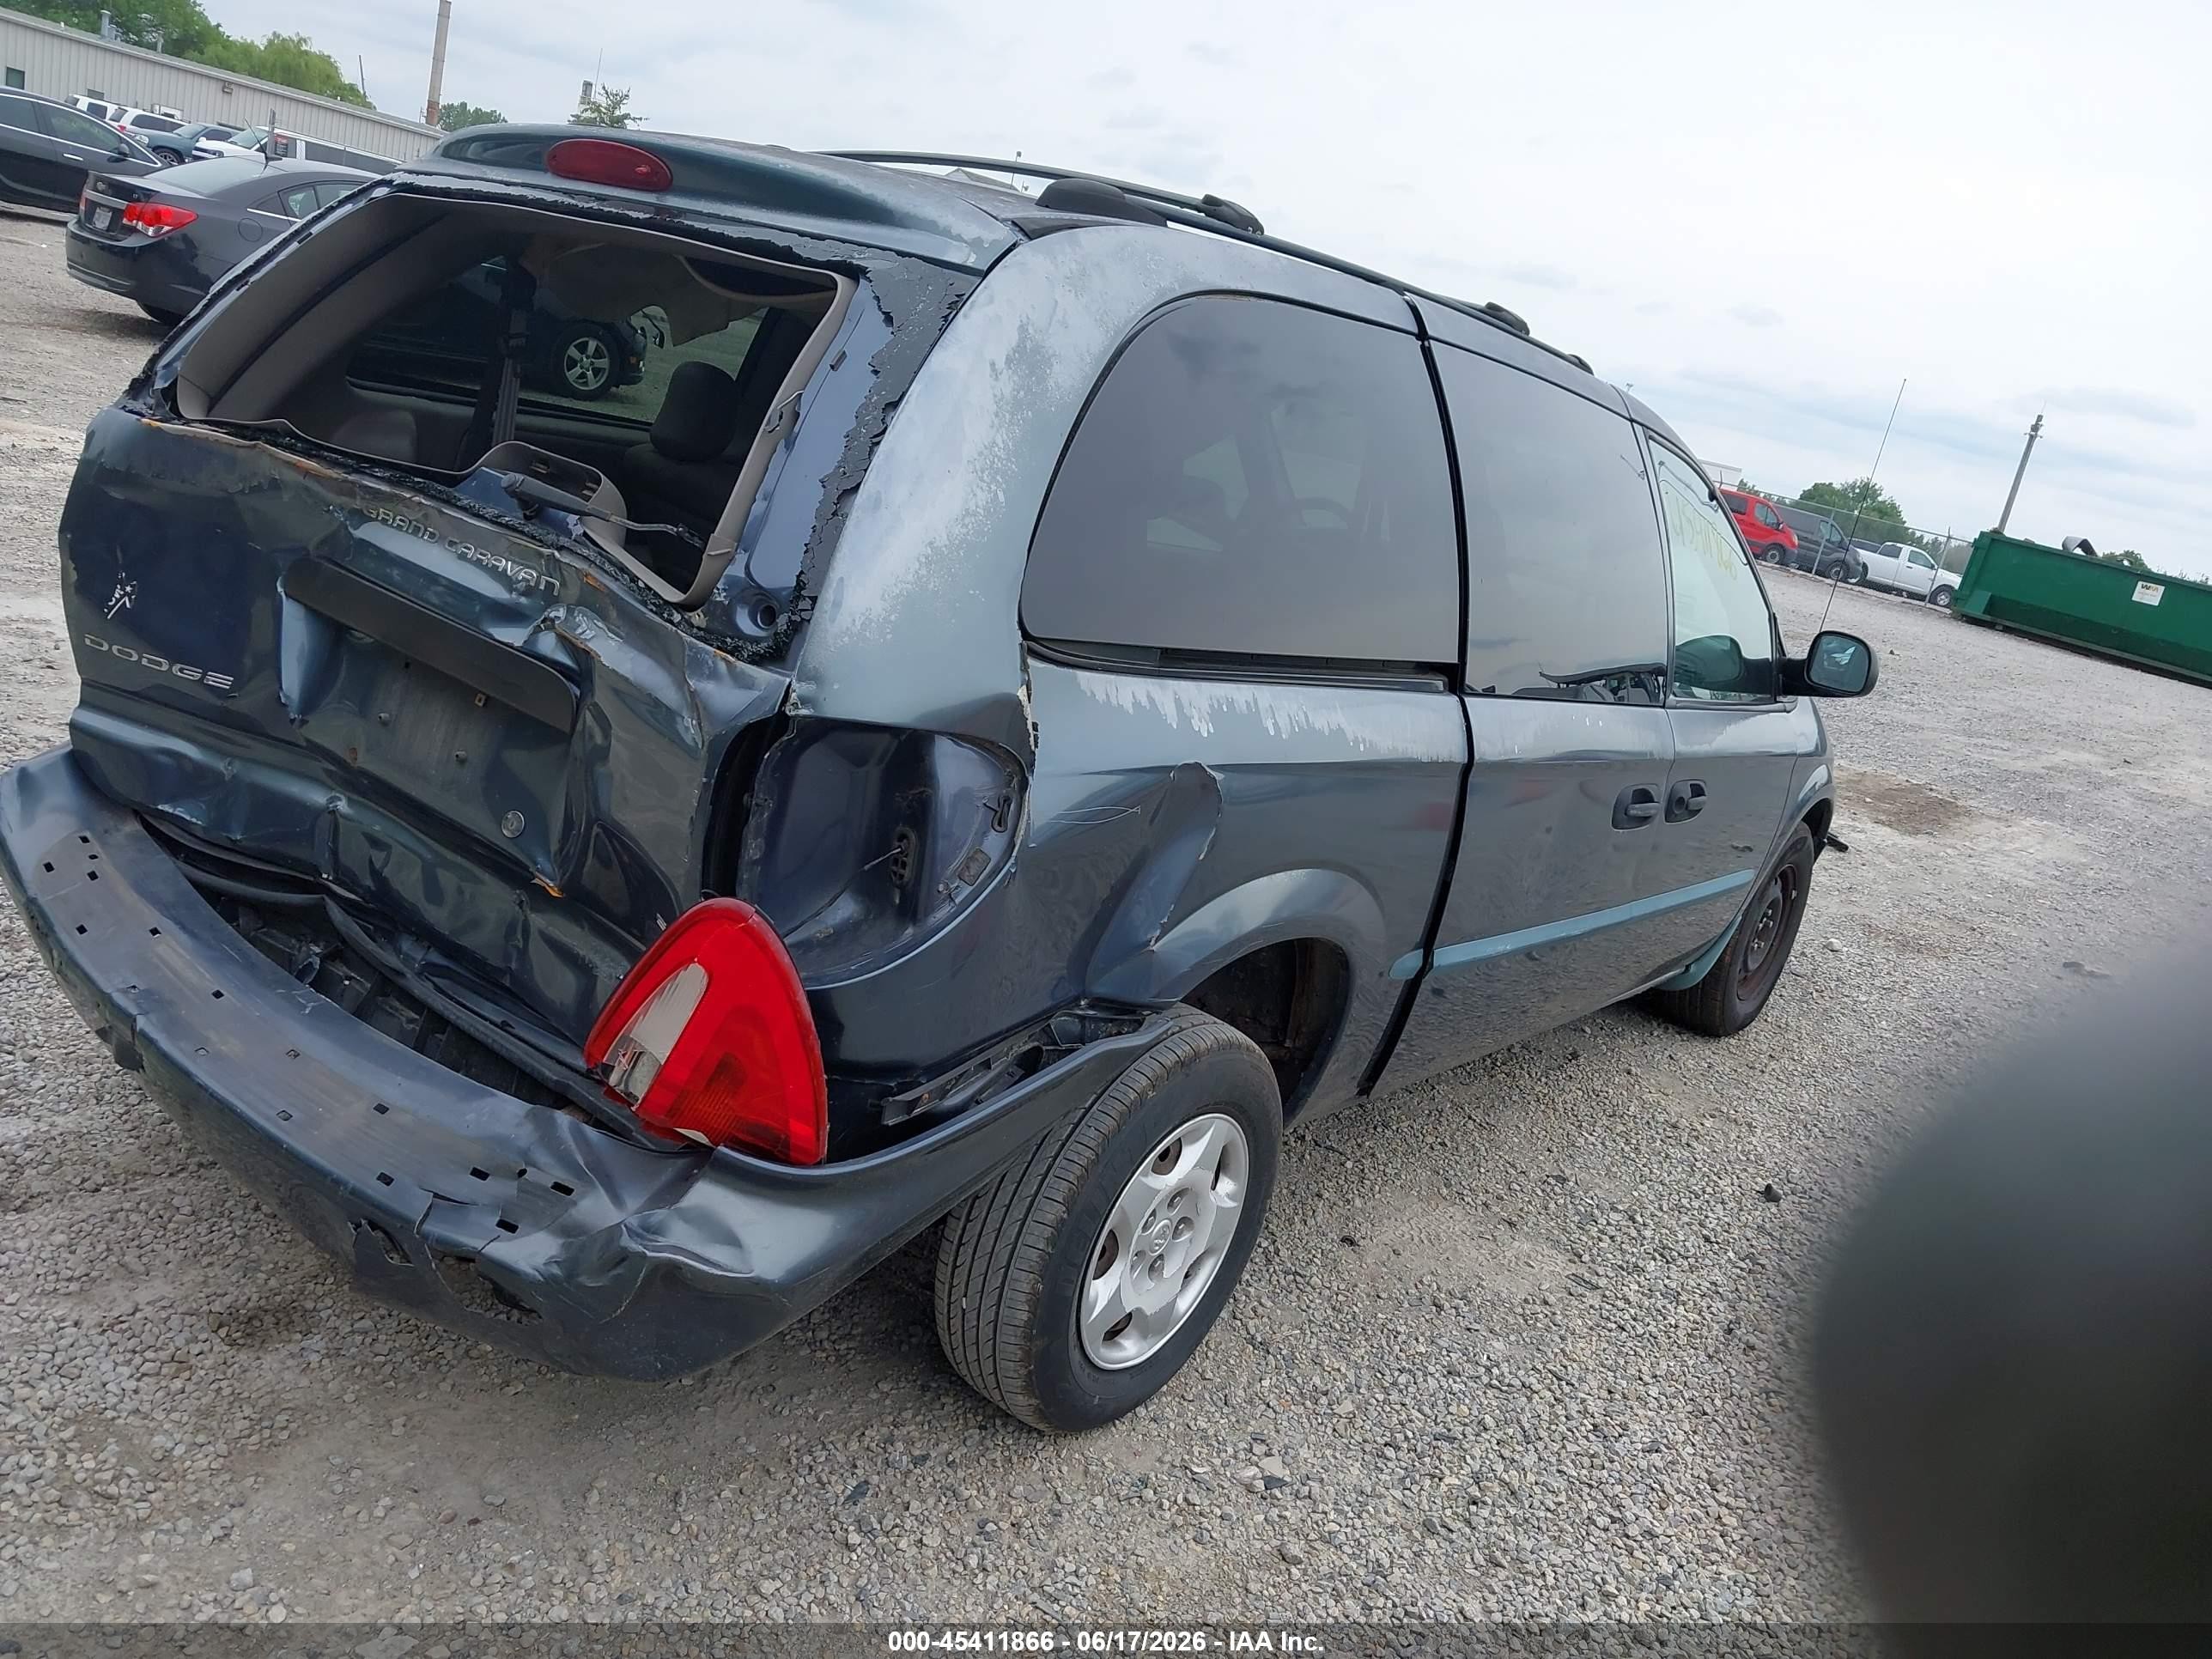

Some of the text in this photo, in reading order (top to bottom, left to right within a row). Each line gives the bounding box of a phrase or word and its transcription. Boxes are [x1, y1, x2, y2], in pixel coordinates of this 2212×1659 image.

[364, 505, 560, 596] GRAND CARAVAN
[84, 633, 234, 690] DODGE
